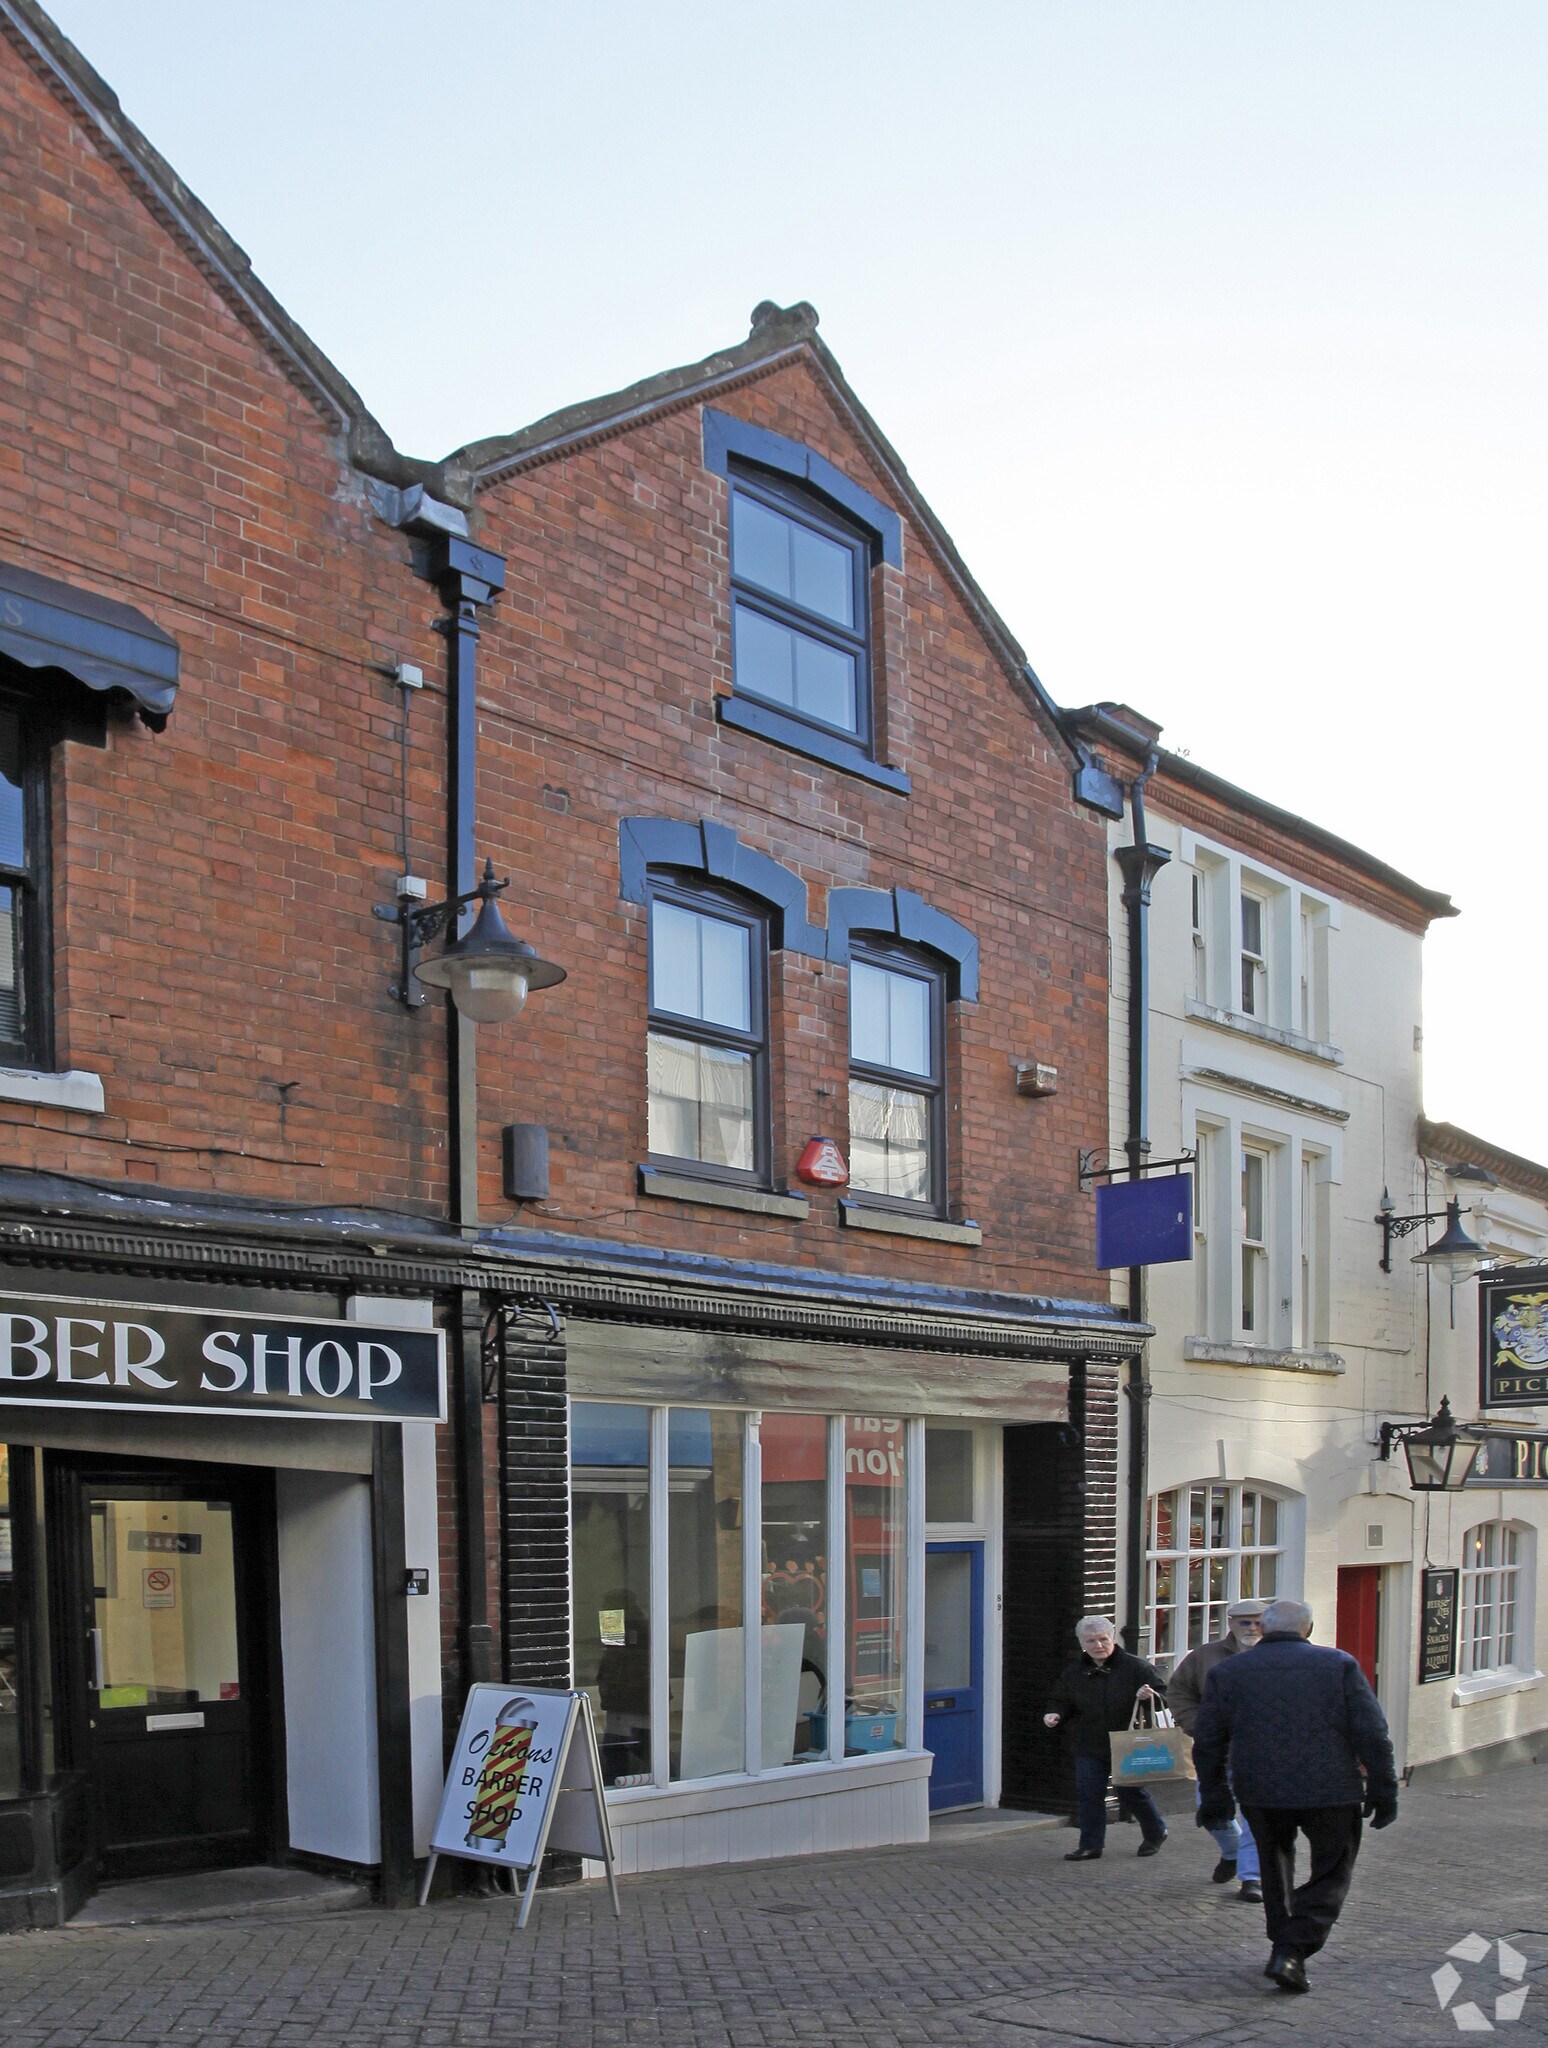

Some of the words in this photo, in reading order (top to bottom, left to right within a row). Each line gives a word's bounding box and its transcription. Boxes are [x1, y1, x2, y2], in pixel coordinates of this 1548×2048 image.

[200, 1331, 402, 1400] SHOP
[1500, 1377, 1548, 1393] PIC
[468, 1729, 554, 1764] Options
[462, 1767, 543, 1797] BARBER
[463, 1800, 523, 1827] SHOP
